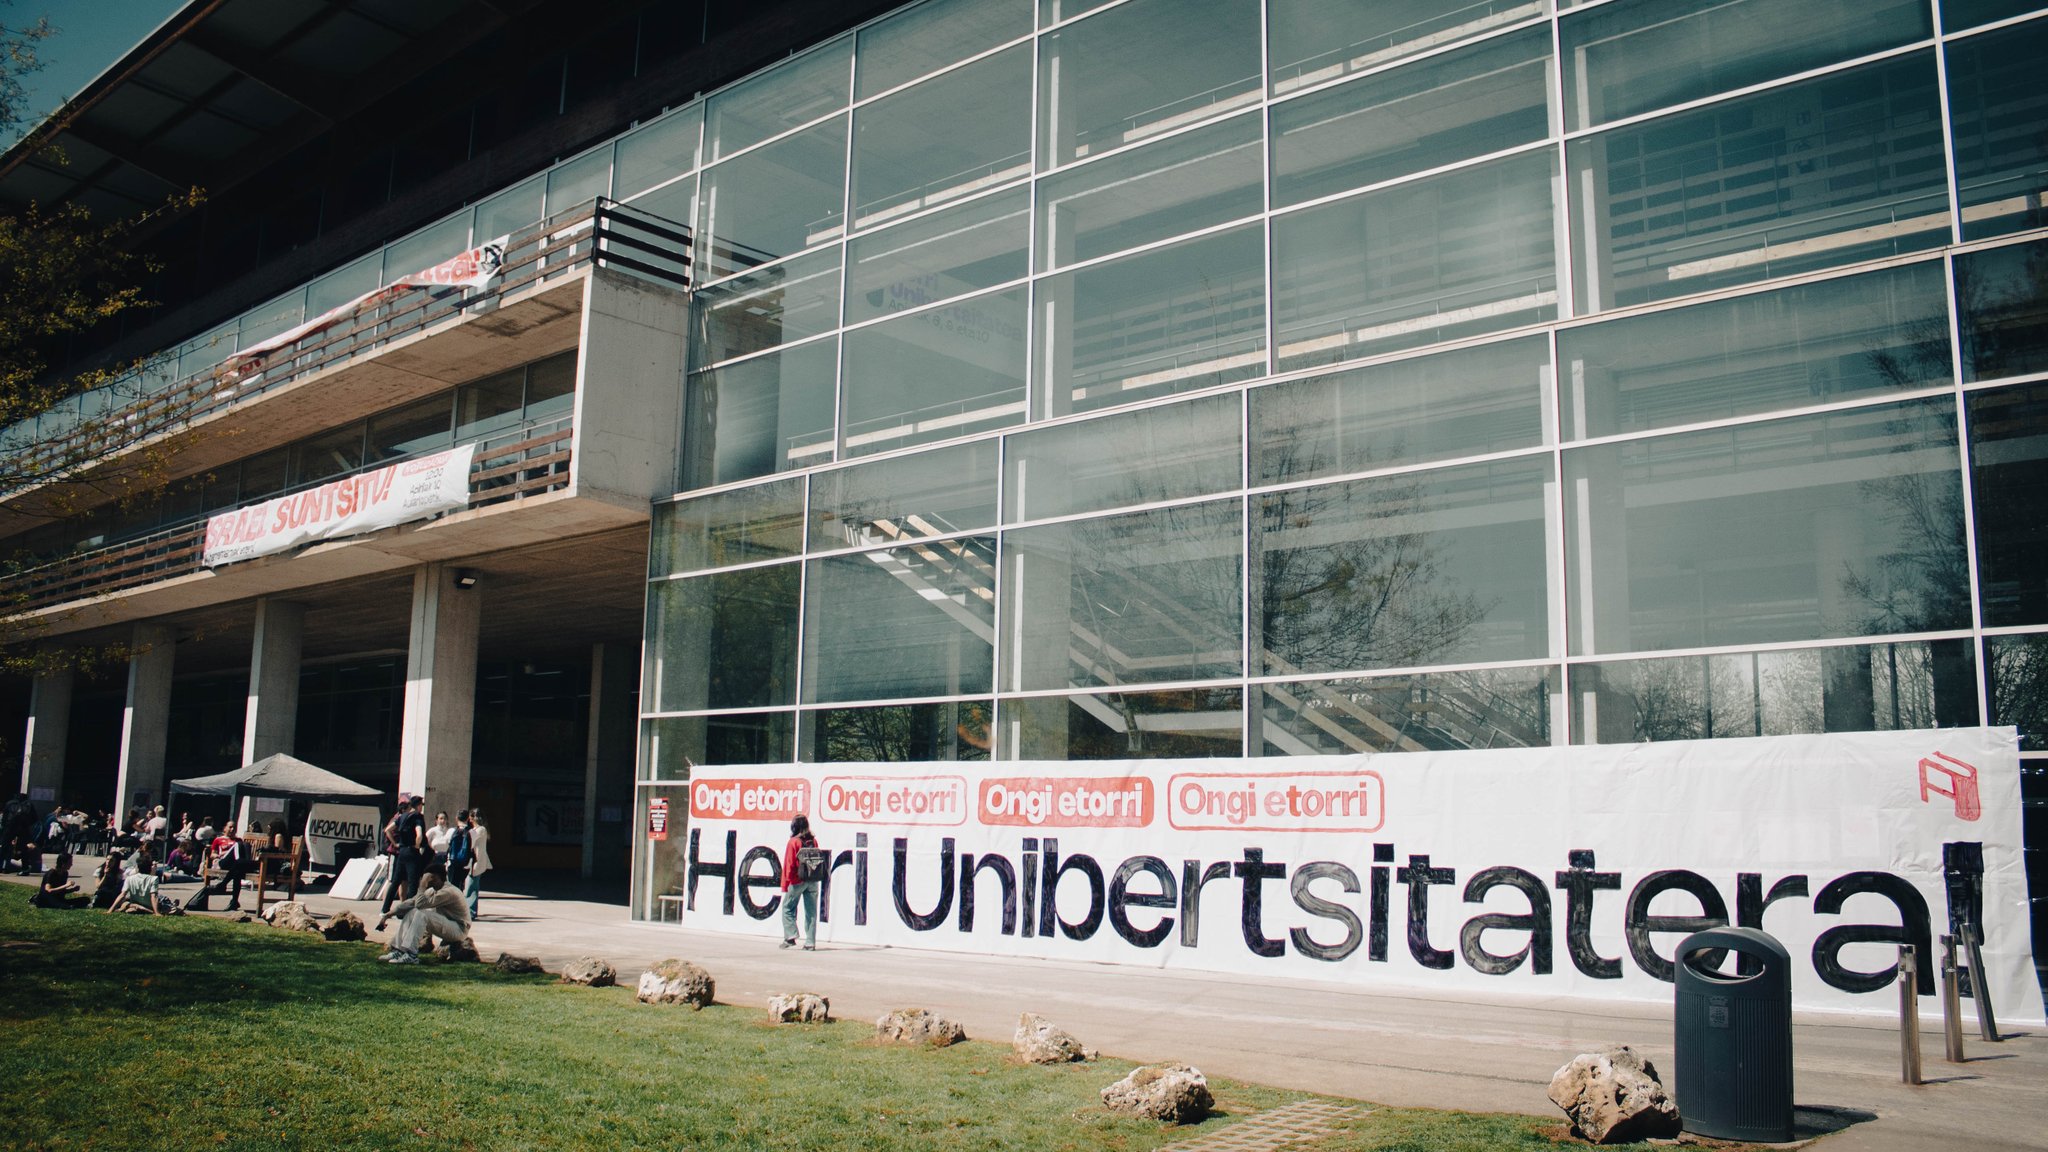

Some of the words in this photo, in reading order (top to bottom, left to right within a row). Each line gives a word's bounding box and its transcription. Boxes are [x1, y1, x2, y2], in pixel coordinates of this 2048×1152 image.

[271, 464, 397, 533] SUNTSITU!
[695, 783, 741, 816] Ongi
[743, 783, 804, 812] etorri
[827, 784, 881, 819] Ongi
[887, 784, 957, 814] etorri
[985, 784, 1052, 824] Ongi
[1060, 783, 1142, 817] etorri
[1179, 782, 1257, 824] Ongi
[1263, 782, 1368, 817] etorri
[310, 819, 375, 840] INFOPUNTUA
[687, 828, 869, 926] Heri
[892, 837, 1985, 998] Unibertsitatera!
